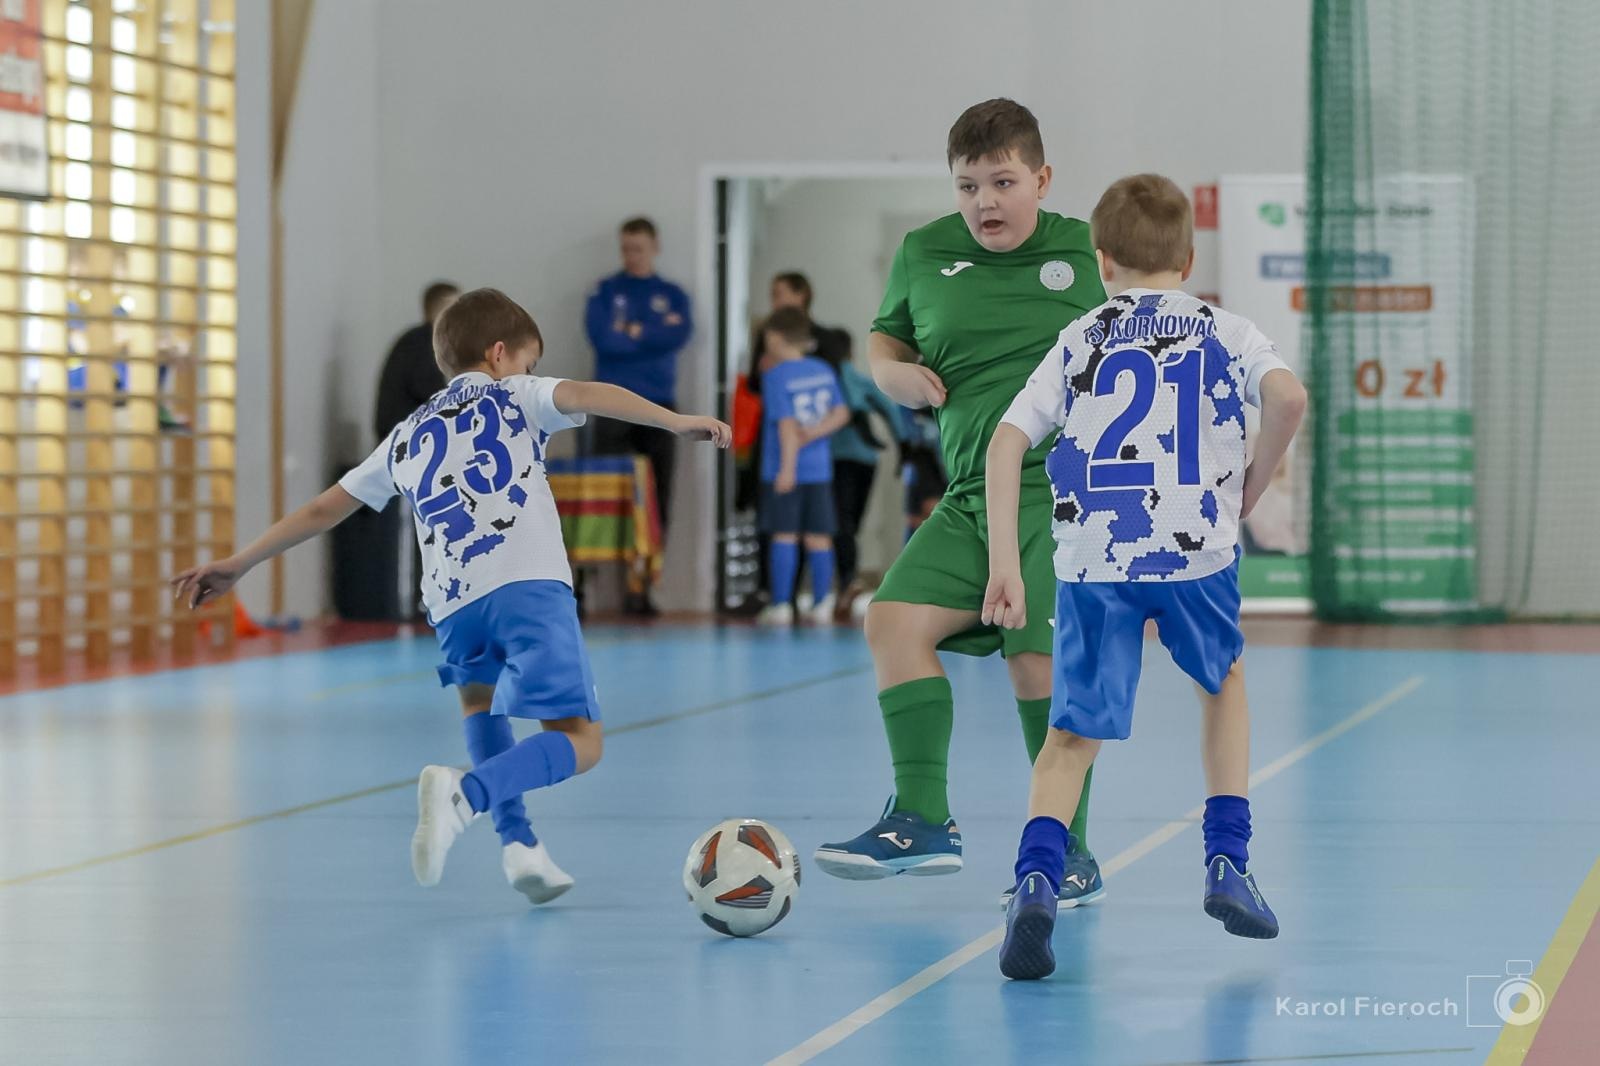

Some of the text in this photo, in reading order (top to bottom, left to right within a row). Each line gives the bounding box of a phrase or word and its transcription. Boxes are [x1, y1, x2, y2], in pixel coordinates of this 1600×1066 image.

[1087, 347, 1204, 491] 21
[1355, 357, 1446, 398] 0 zł
[407, 394, 514, 525] 23
